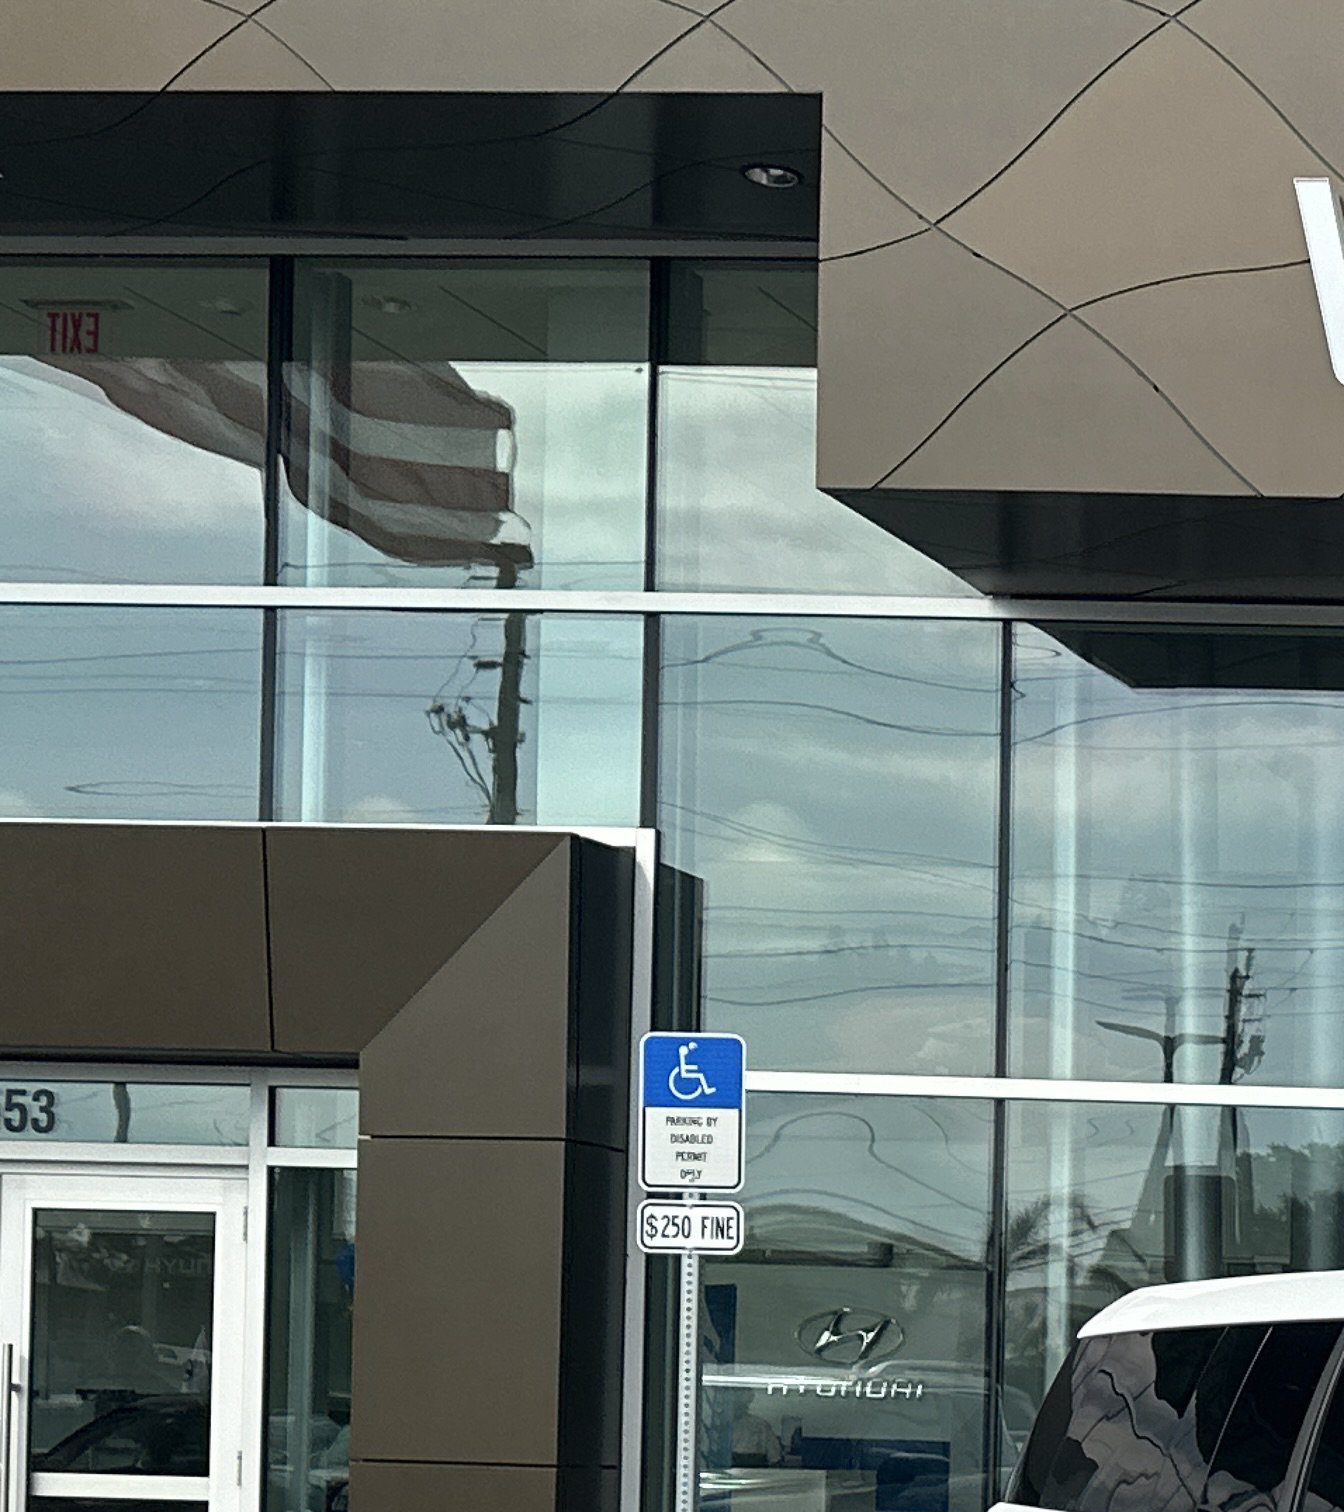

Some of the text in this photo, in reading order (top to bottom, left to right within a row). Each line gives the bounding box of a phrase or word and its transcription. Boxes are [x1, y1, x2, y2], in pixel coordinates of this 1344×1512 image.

[3, 1088, 55, 1134] 53
[645, 1213, 735, 1241] $250 FINE
